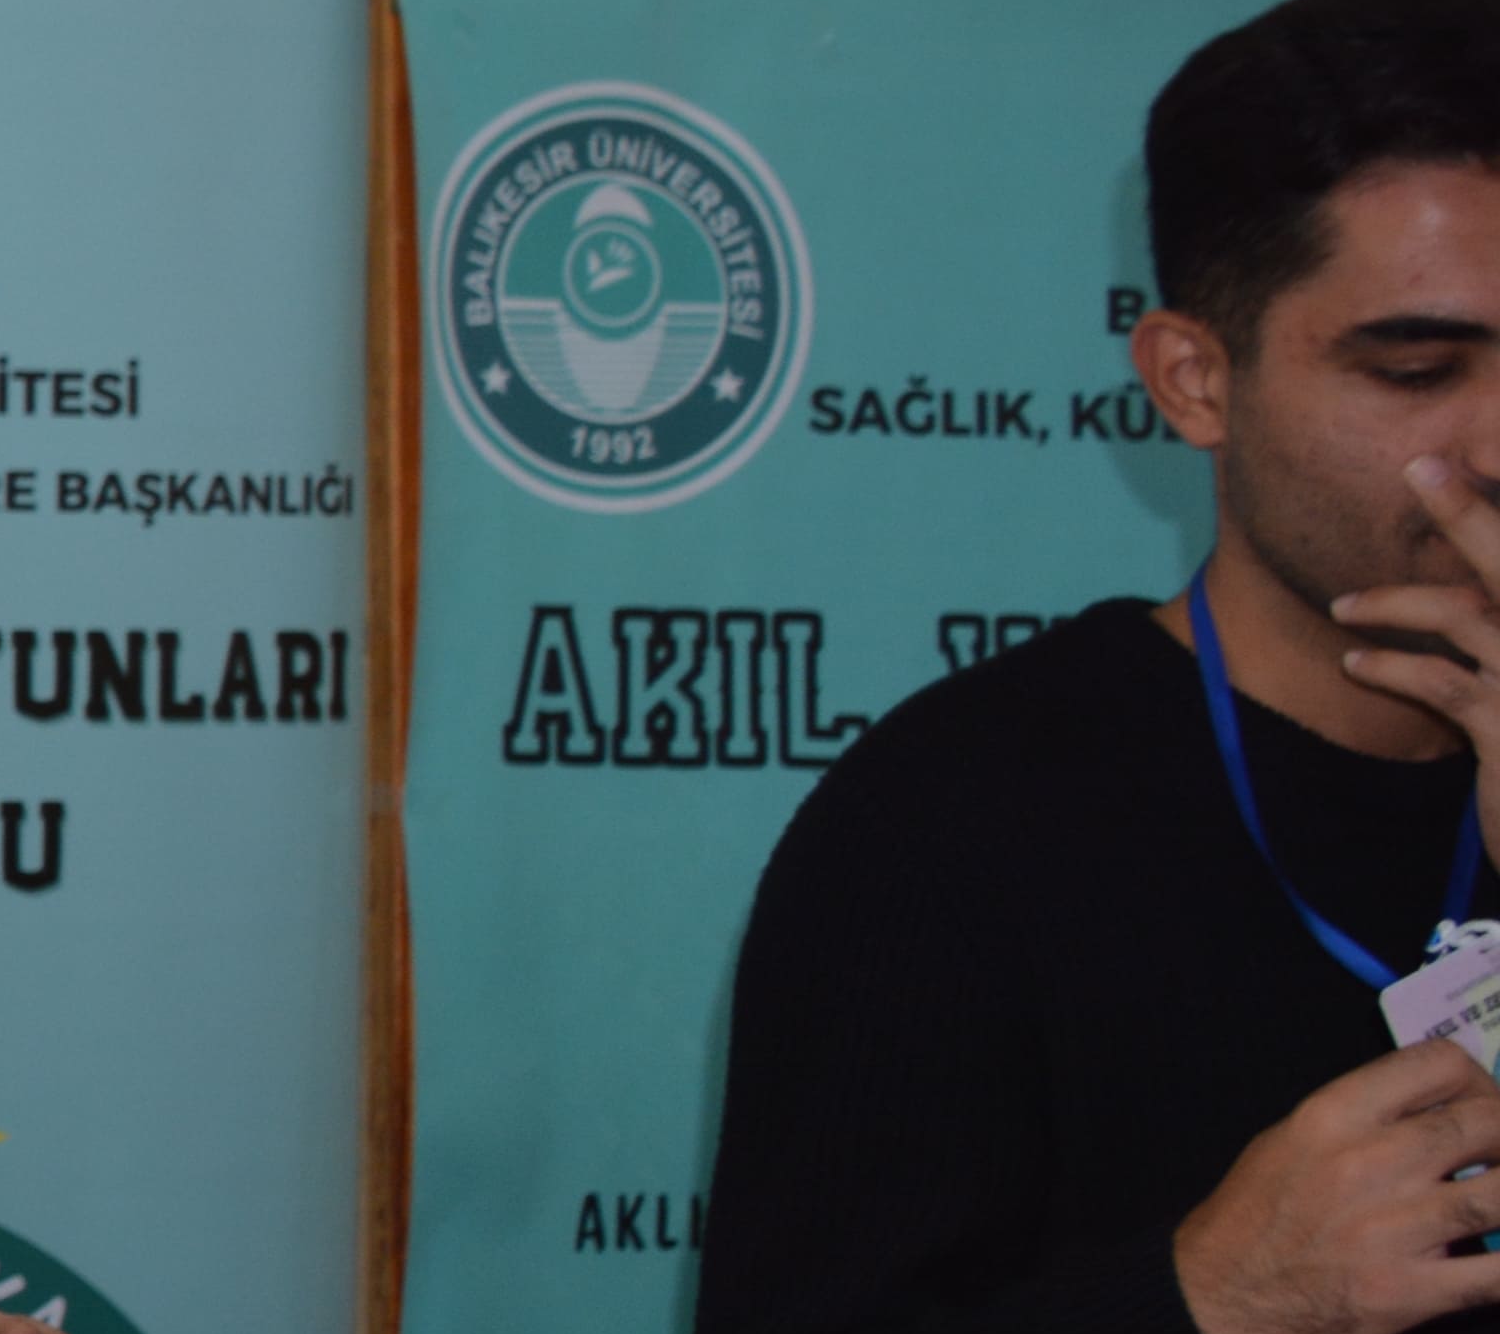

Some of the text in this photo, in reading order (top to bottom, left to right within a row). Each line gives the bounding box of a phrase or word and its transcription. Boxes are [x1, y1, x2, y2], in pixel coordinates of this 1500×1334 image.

[464, 128, 765, 341] BALIKESİR ÜNİVERSİTESİ
[569, 424, 658, 465] 1992
[808, 376, 1051, 446] SAĞLIK,
[56, 461, 356, 528] BAŞKANLIĞI
[502, 605, 871, 770] AKIL
